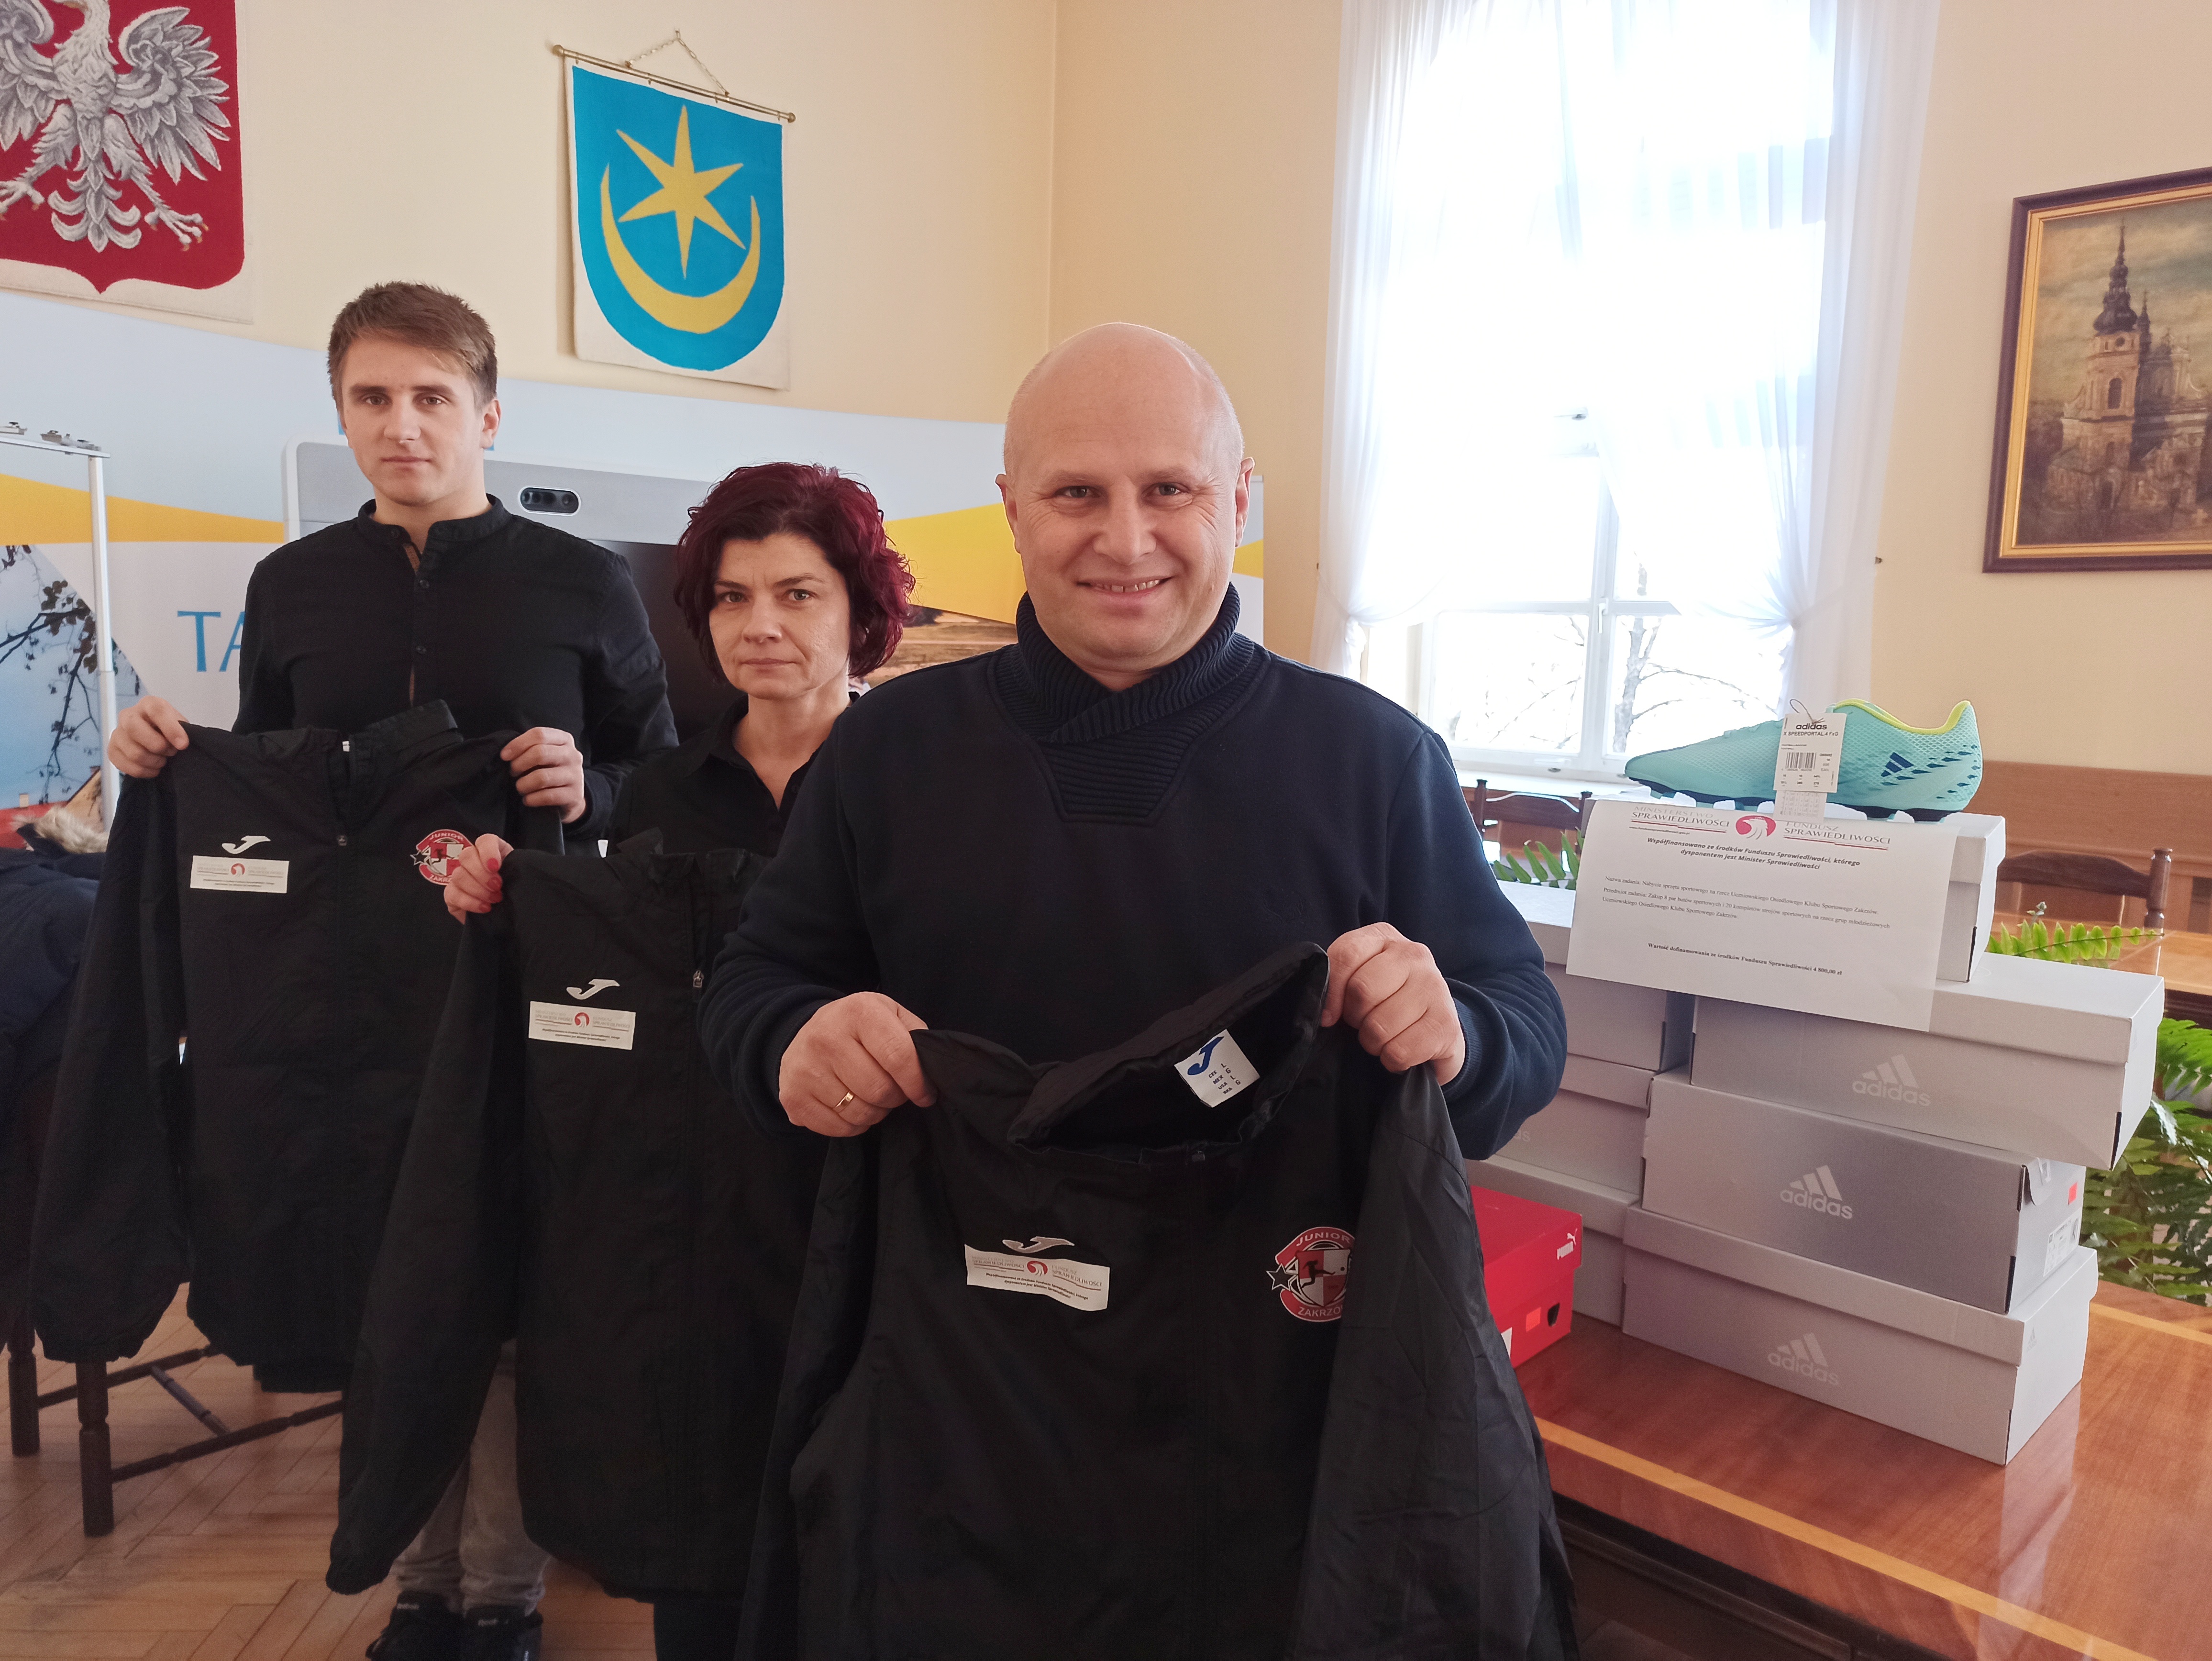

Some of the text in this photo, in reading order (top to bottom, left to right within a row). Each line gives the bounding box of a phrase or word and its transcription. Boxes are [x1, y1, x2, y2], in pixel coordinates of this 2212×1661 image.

[1634, 806, 1713, 818] MINISTERSTWO
[1786, 821, 1839, 831] FUNDUSZ
[429, 832, 464, 841] JUNIOR
[1784, 828, 1891, 844] SPRAWIEDLIWOŚCI
[1648, 837, 1706, 849] Współfinansowano
[1715, 844, 1744, 853] środków
[1744, 848, 1775, 856] Funduszu
[1776, 852, 1831, 863] Sprawiedliwości,
[1833, 857, 1860, 867] którego
[1681, 849, 1723, 860] dysponentem
[1766, 858, 1821, 869] Sprawiedliwości
[1602, 897, 1637, 906] Uczniowskiego
[1638, 901, 1669, 910] Osiedlowego
[1686, 907, 1715, 916] Sportowego
[1681, 886, 1708, 894] sportowego
[1731, 891, 1769, 901] Uczniowskiego
[1770, 896, 1803, 906] Osiedlowego
[1822, 903, 1853, 912] Sportowego
[1693, 899, 1721, 908] sportowych
[1782, 910, 1812, 919] sportowych
[1648, 942, 1669, 951] Wartość
[1670, 946, 1709, 956] dofinansowania
[1717, 952, 1739, 961] środków
[1741, 956, 1767, 964] Funduszu
[1768, 960, 1812, 972] Sprawiedliwości
[1213, 1075, 1224, 1084] MEX
[1852, 1080, 1931, 1107] adidas
[1780, 1189, 1853, 1219] adidas
[1296, 1232, 1350, 1247] JUNIOR
[1298, 1305, 1343, 1317] ZAKRZÓ
[1768, 1352, 1839, 1385] adidas
